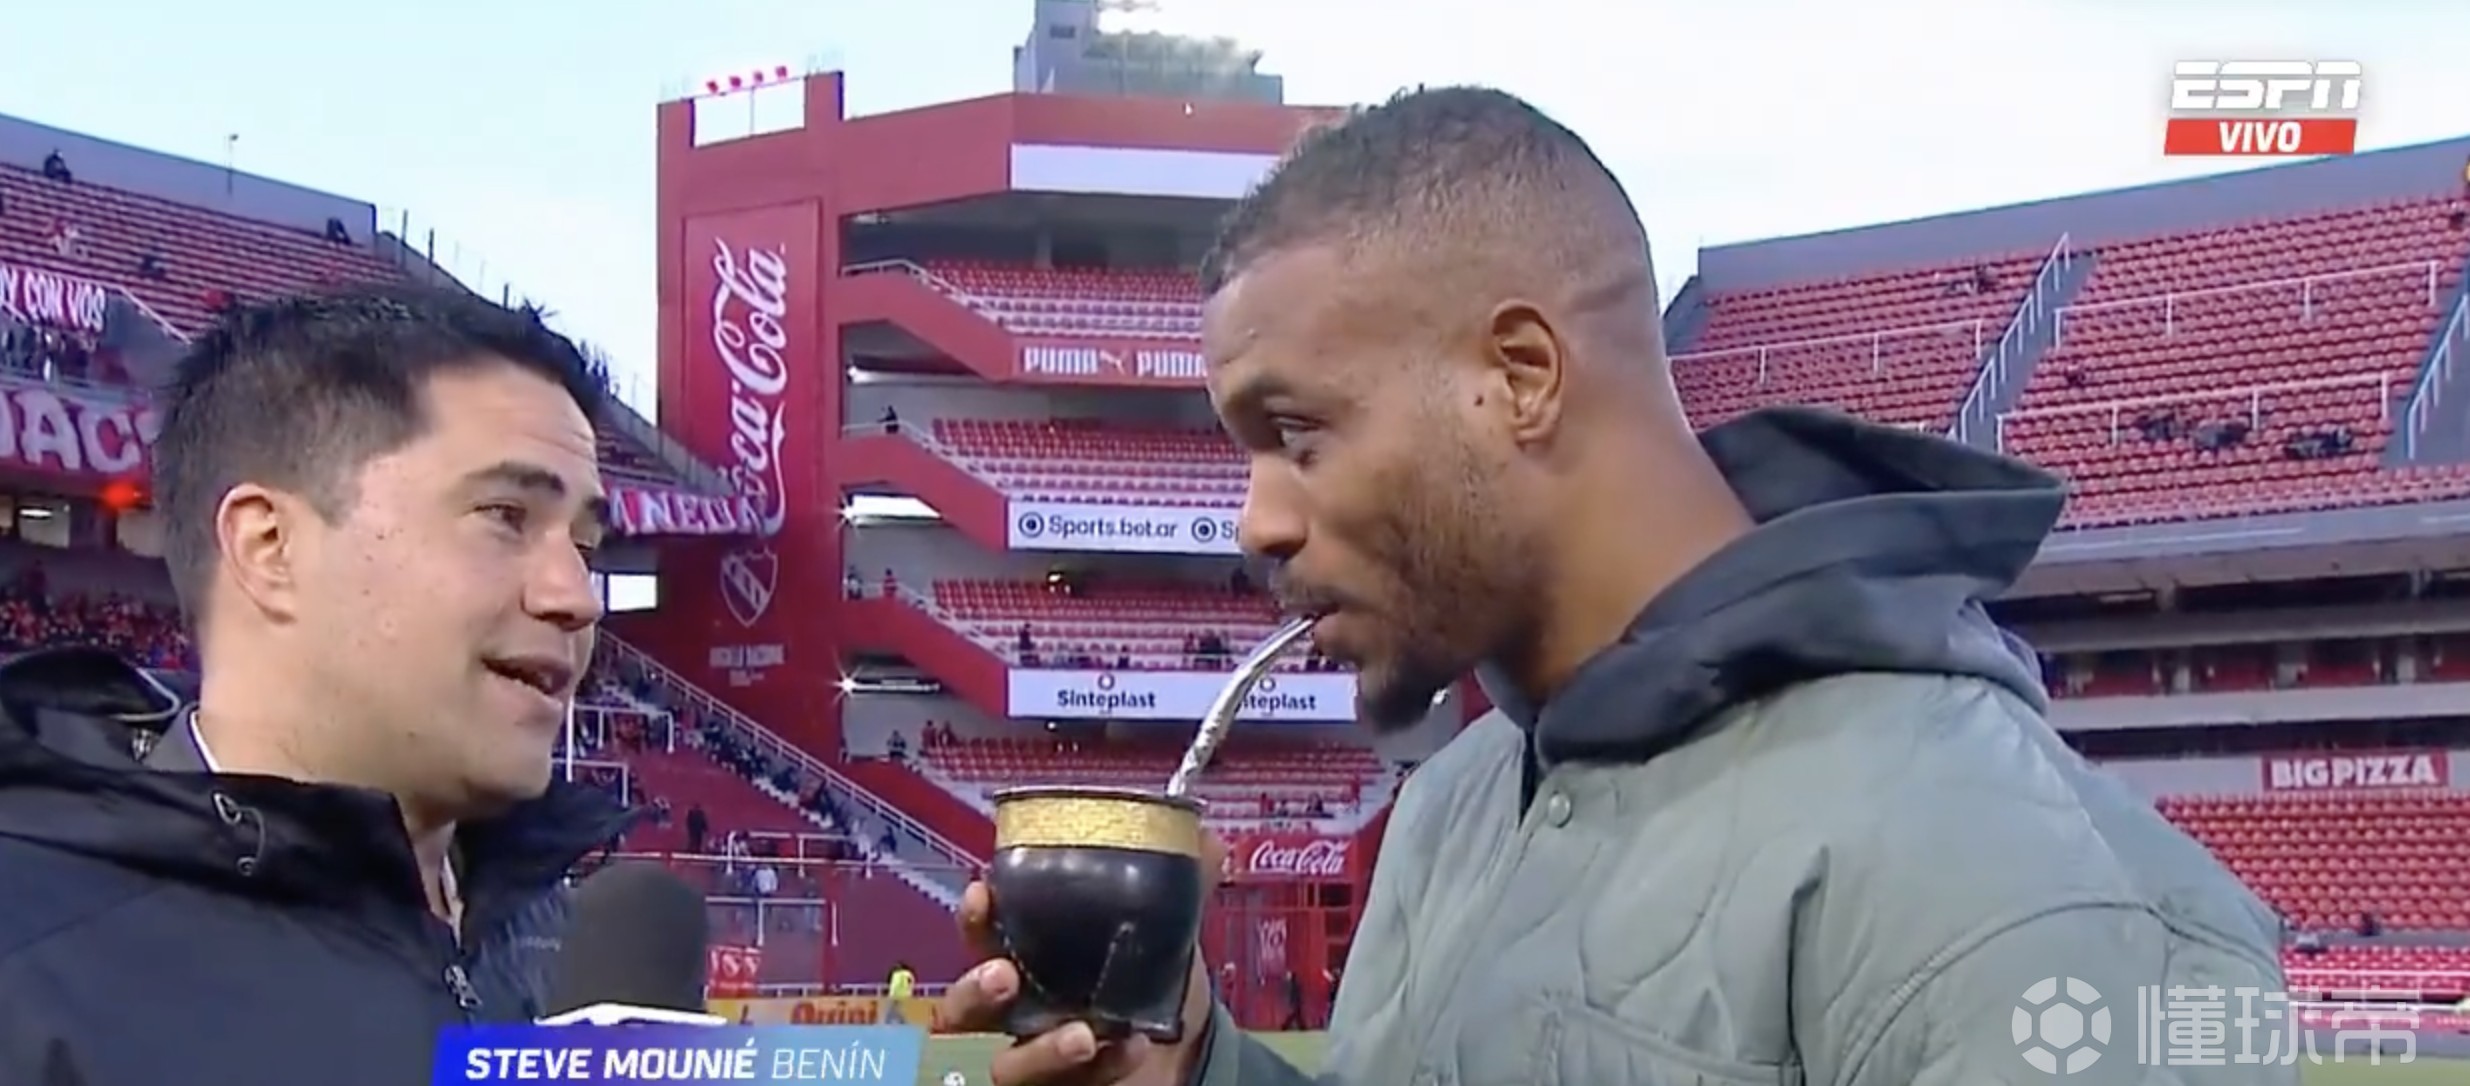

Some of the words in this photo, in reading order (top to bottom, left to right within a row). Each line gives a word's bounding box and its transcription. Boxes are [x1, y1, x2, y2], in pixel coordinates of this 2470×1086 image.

[1024, 346, 1099, 374] PUMA
[1057, 690, 1156, 709] Sinteplast
[1242, 693, 1317, 711] teplast
[2271, 759, 2329, 788] BIG
[2332, 754, 2439, 787] PIZZA
